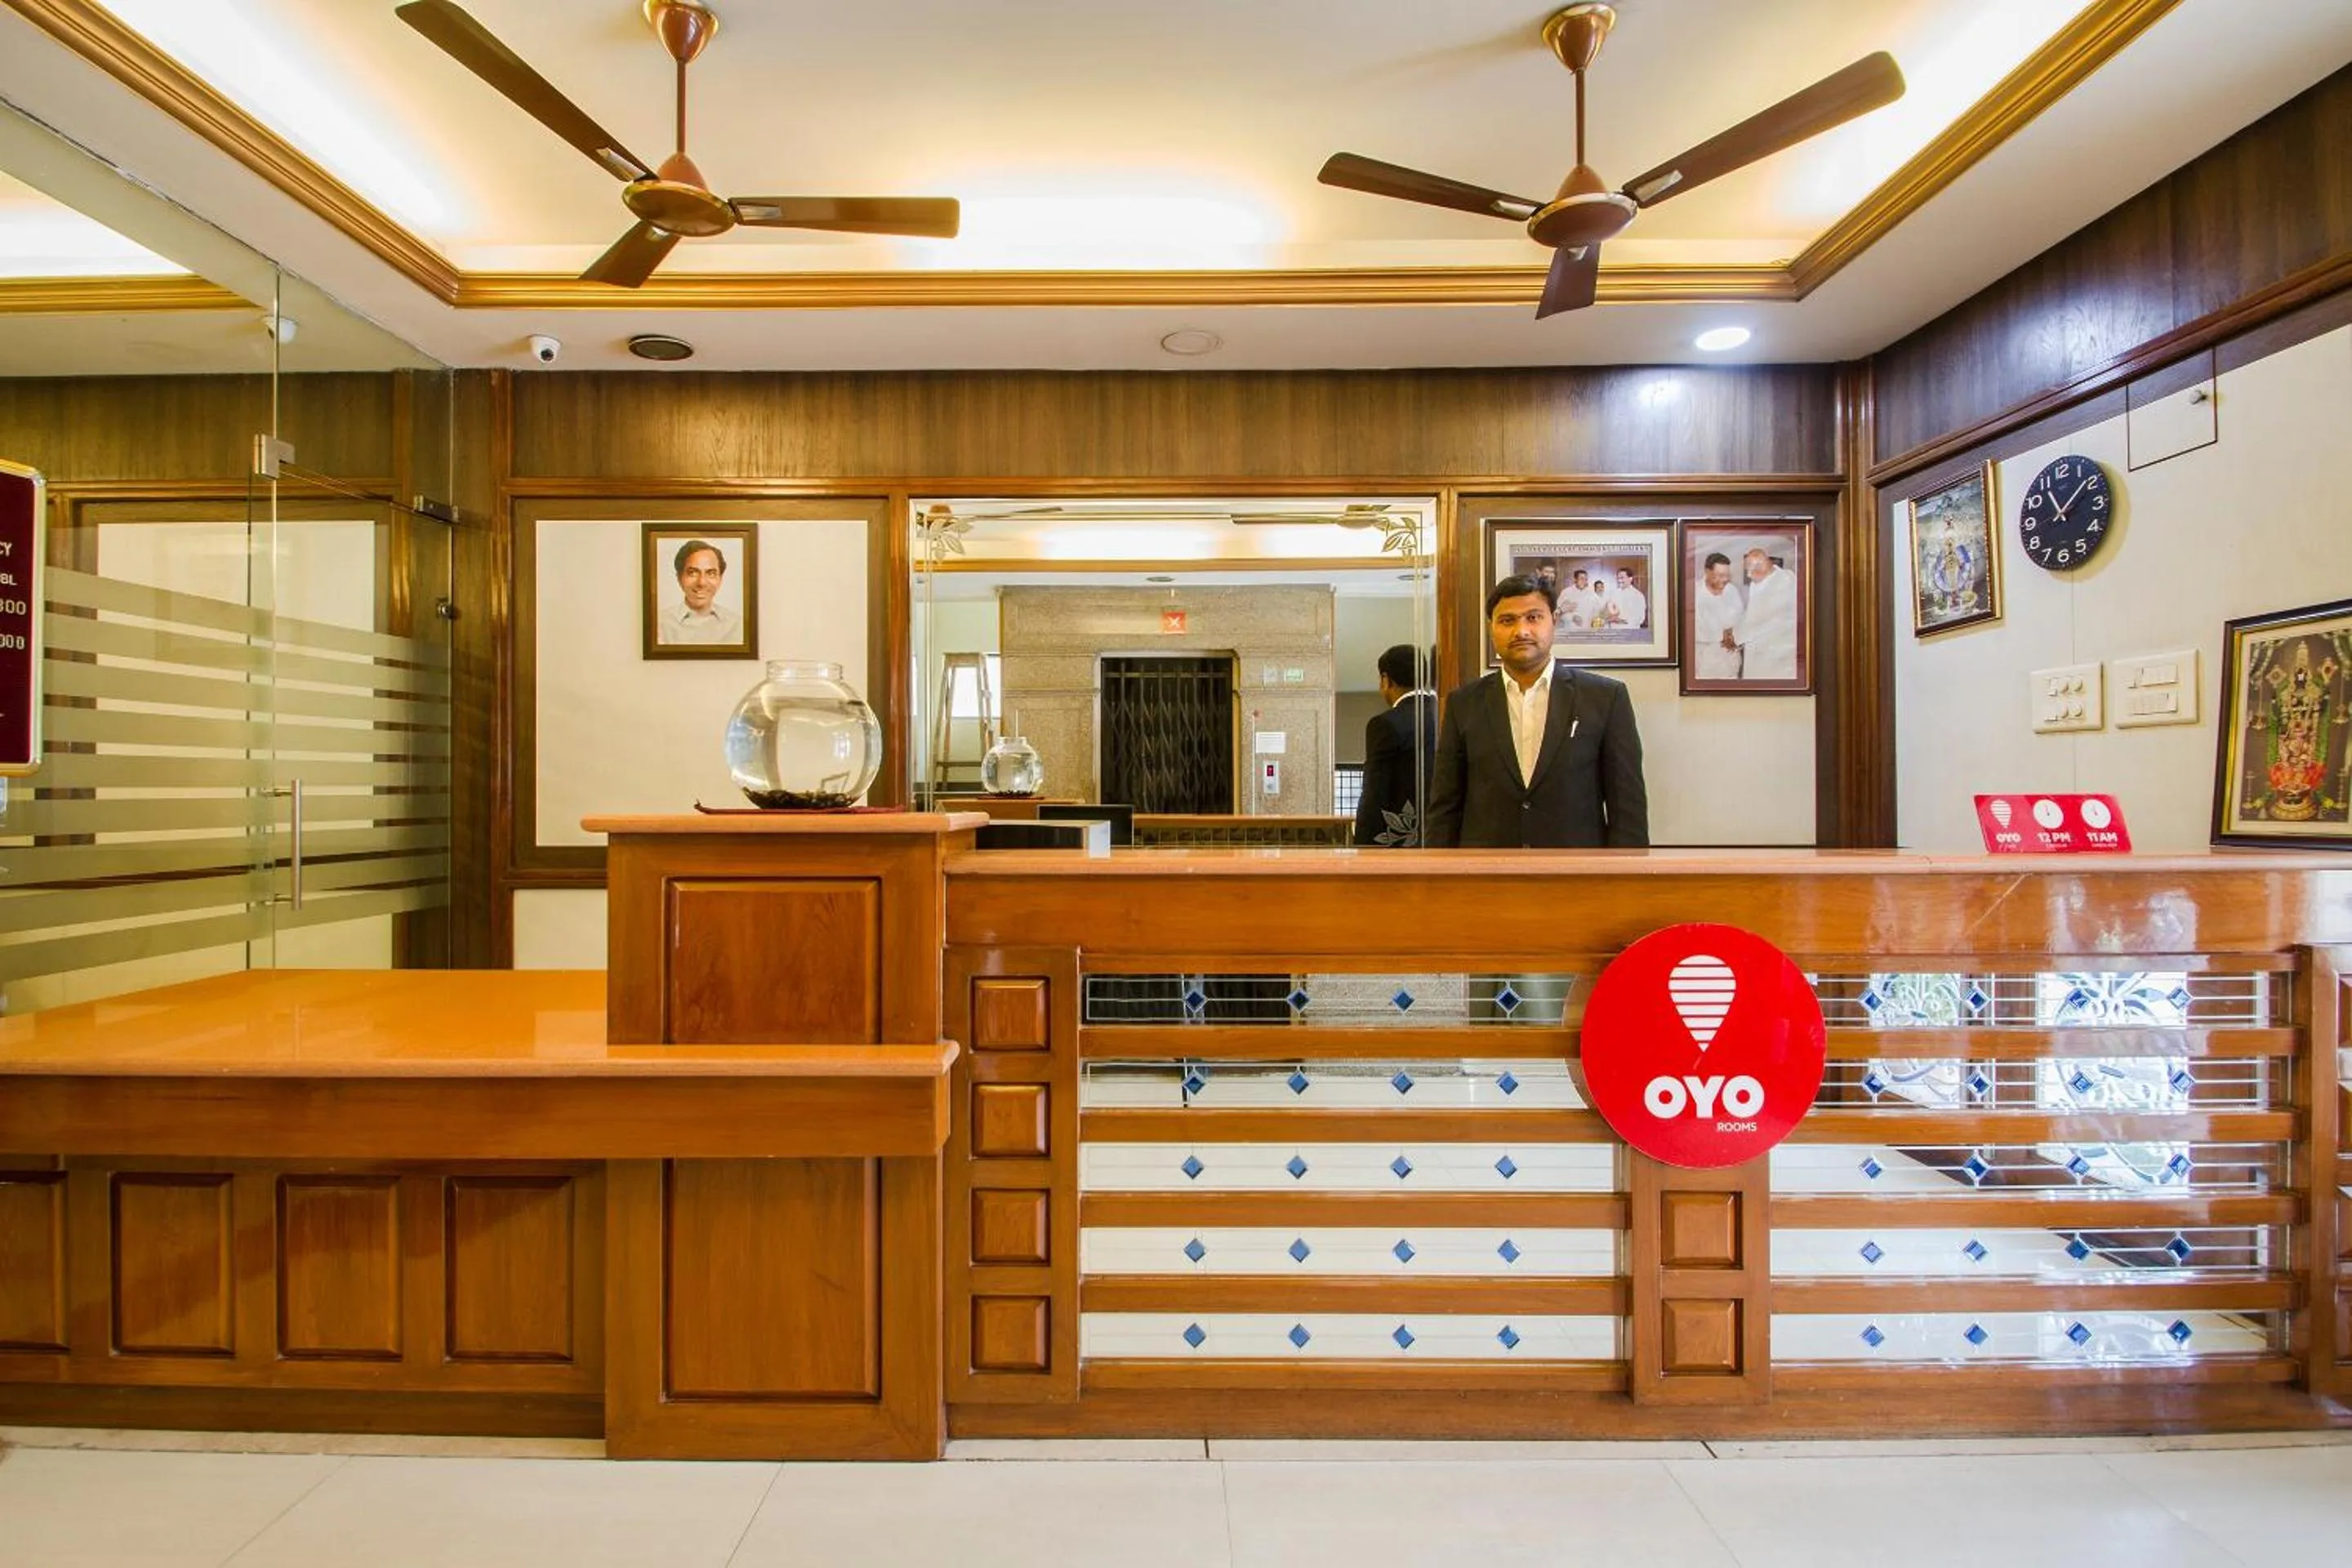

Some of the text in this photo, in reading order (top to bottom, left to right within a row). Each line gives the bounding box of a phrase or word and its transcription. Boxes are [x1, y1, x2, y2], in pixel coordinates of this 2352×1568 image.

[2055, 463, 2069, 479] 12
[2077, 465, 2082, 477] 1
[2041, 475, 2051, 490] 11
[2087, 474, 2098, 490] 2
[2025, 495, 2042, 510] 10
[2091, 496, 2104, 510] 3
[2025, 517, 2036, 531] 9
[2086, 519, 2100, 532] 4
[2029, 536, 2040, 550] 8
[2075, 539, 2087, 553] 5
[2042, 548, 2052, 562] 7
[2057, 549, 2069, 563] 6
[1996, 832, 2021, 843] OYO
[2038, 832, 2070, 843] 12 PM
[2086, 832, 2118, 843] 11 AM
[1644, 1075, 1765, 1119] OYO
[1717, 1122, 1757, 1132] ROOMS
